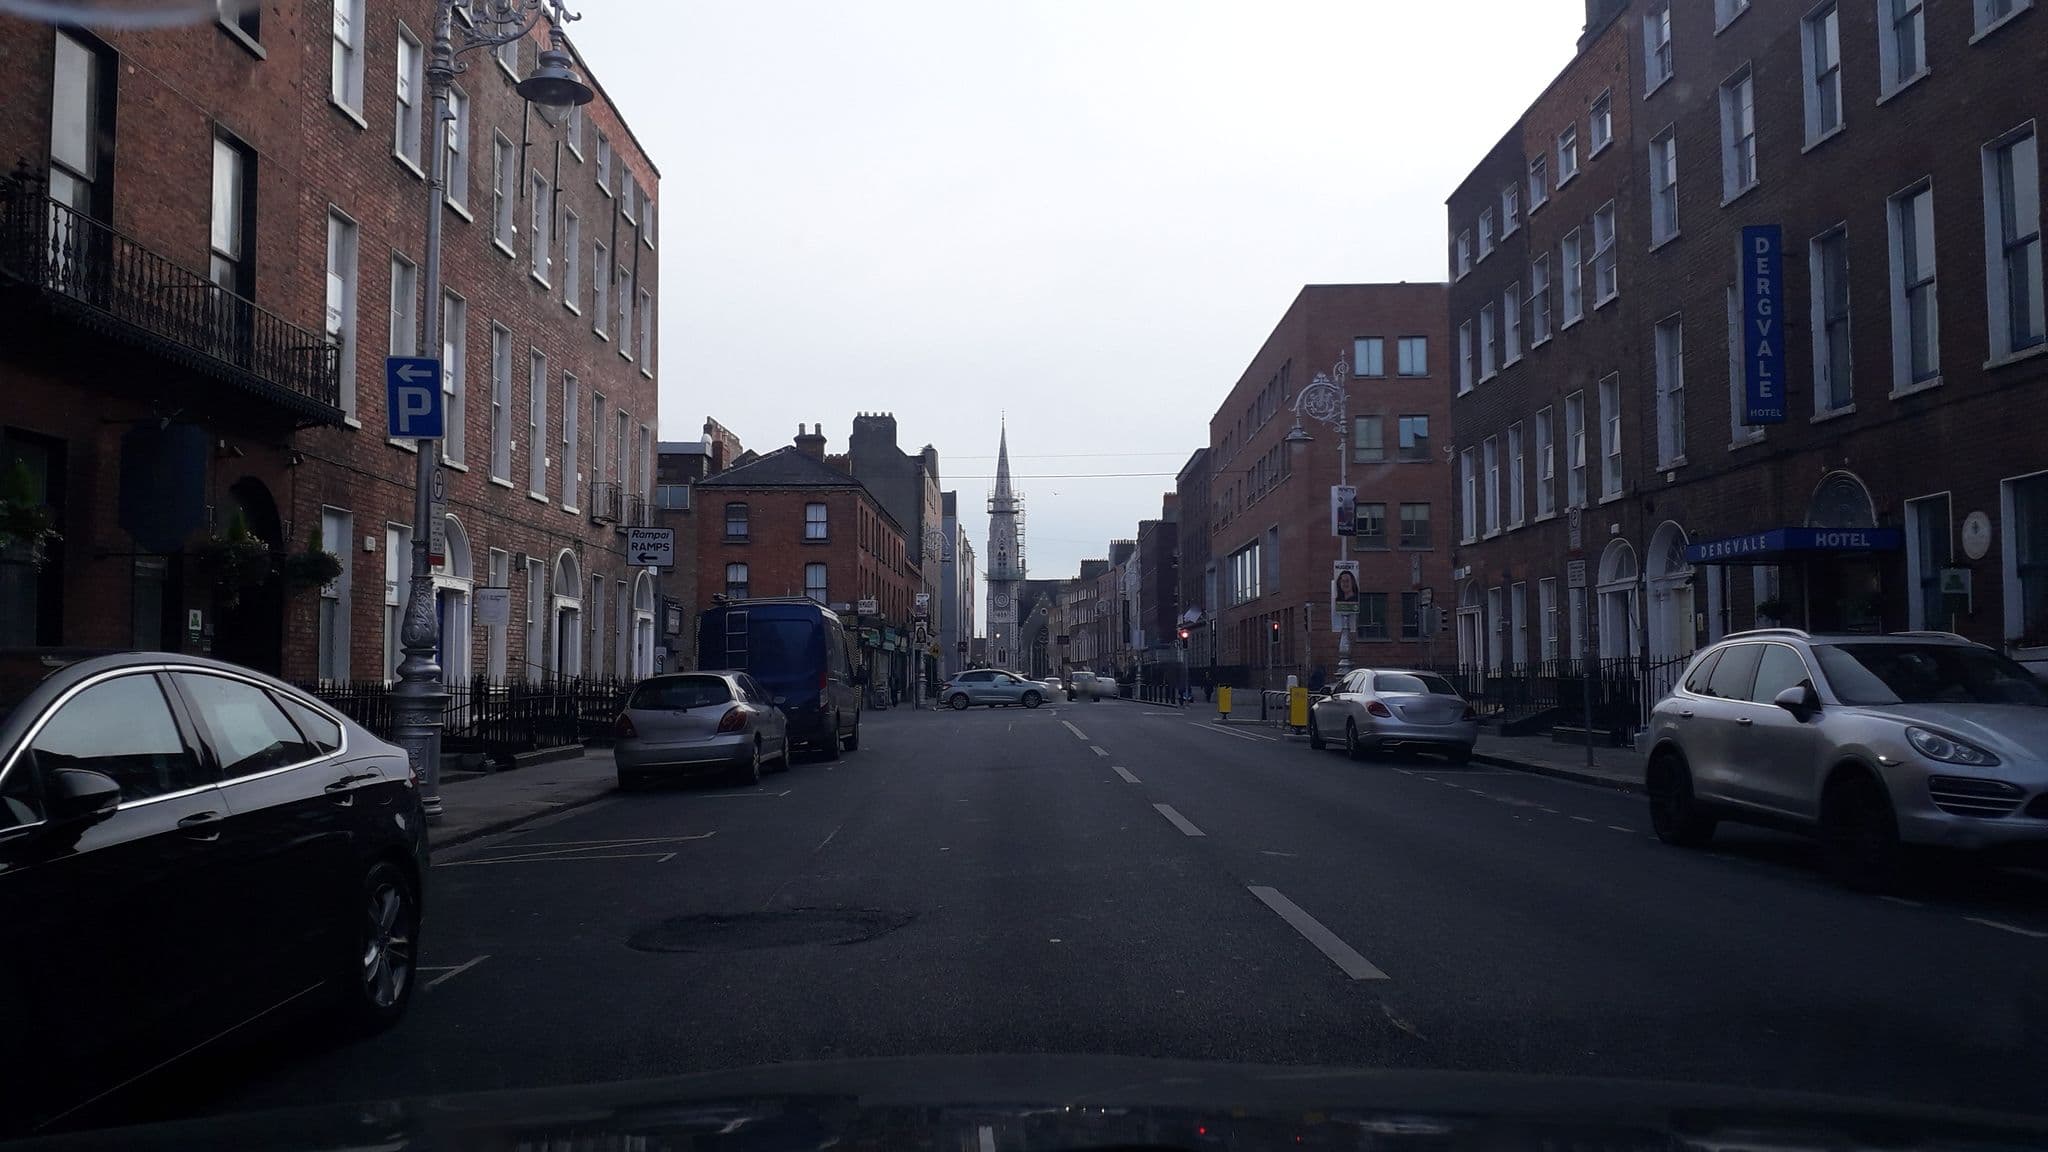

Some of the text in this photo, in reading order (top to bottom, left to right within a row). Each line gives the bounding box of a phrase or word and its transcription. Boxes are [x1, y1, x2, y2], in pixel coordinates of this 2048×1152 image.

[1755, 236, 1773, 399] DERGVALE
[398, 386, 432, 432] P
[1750, 408, 1782, 417] HOTEL
[632, 542, 670, 551] RAMPS
[1701, 532, 1871, 558] DERGVALE HOTEL
